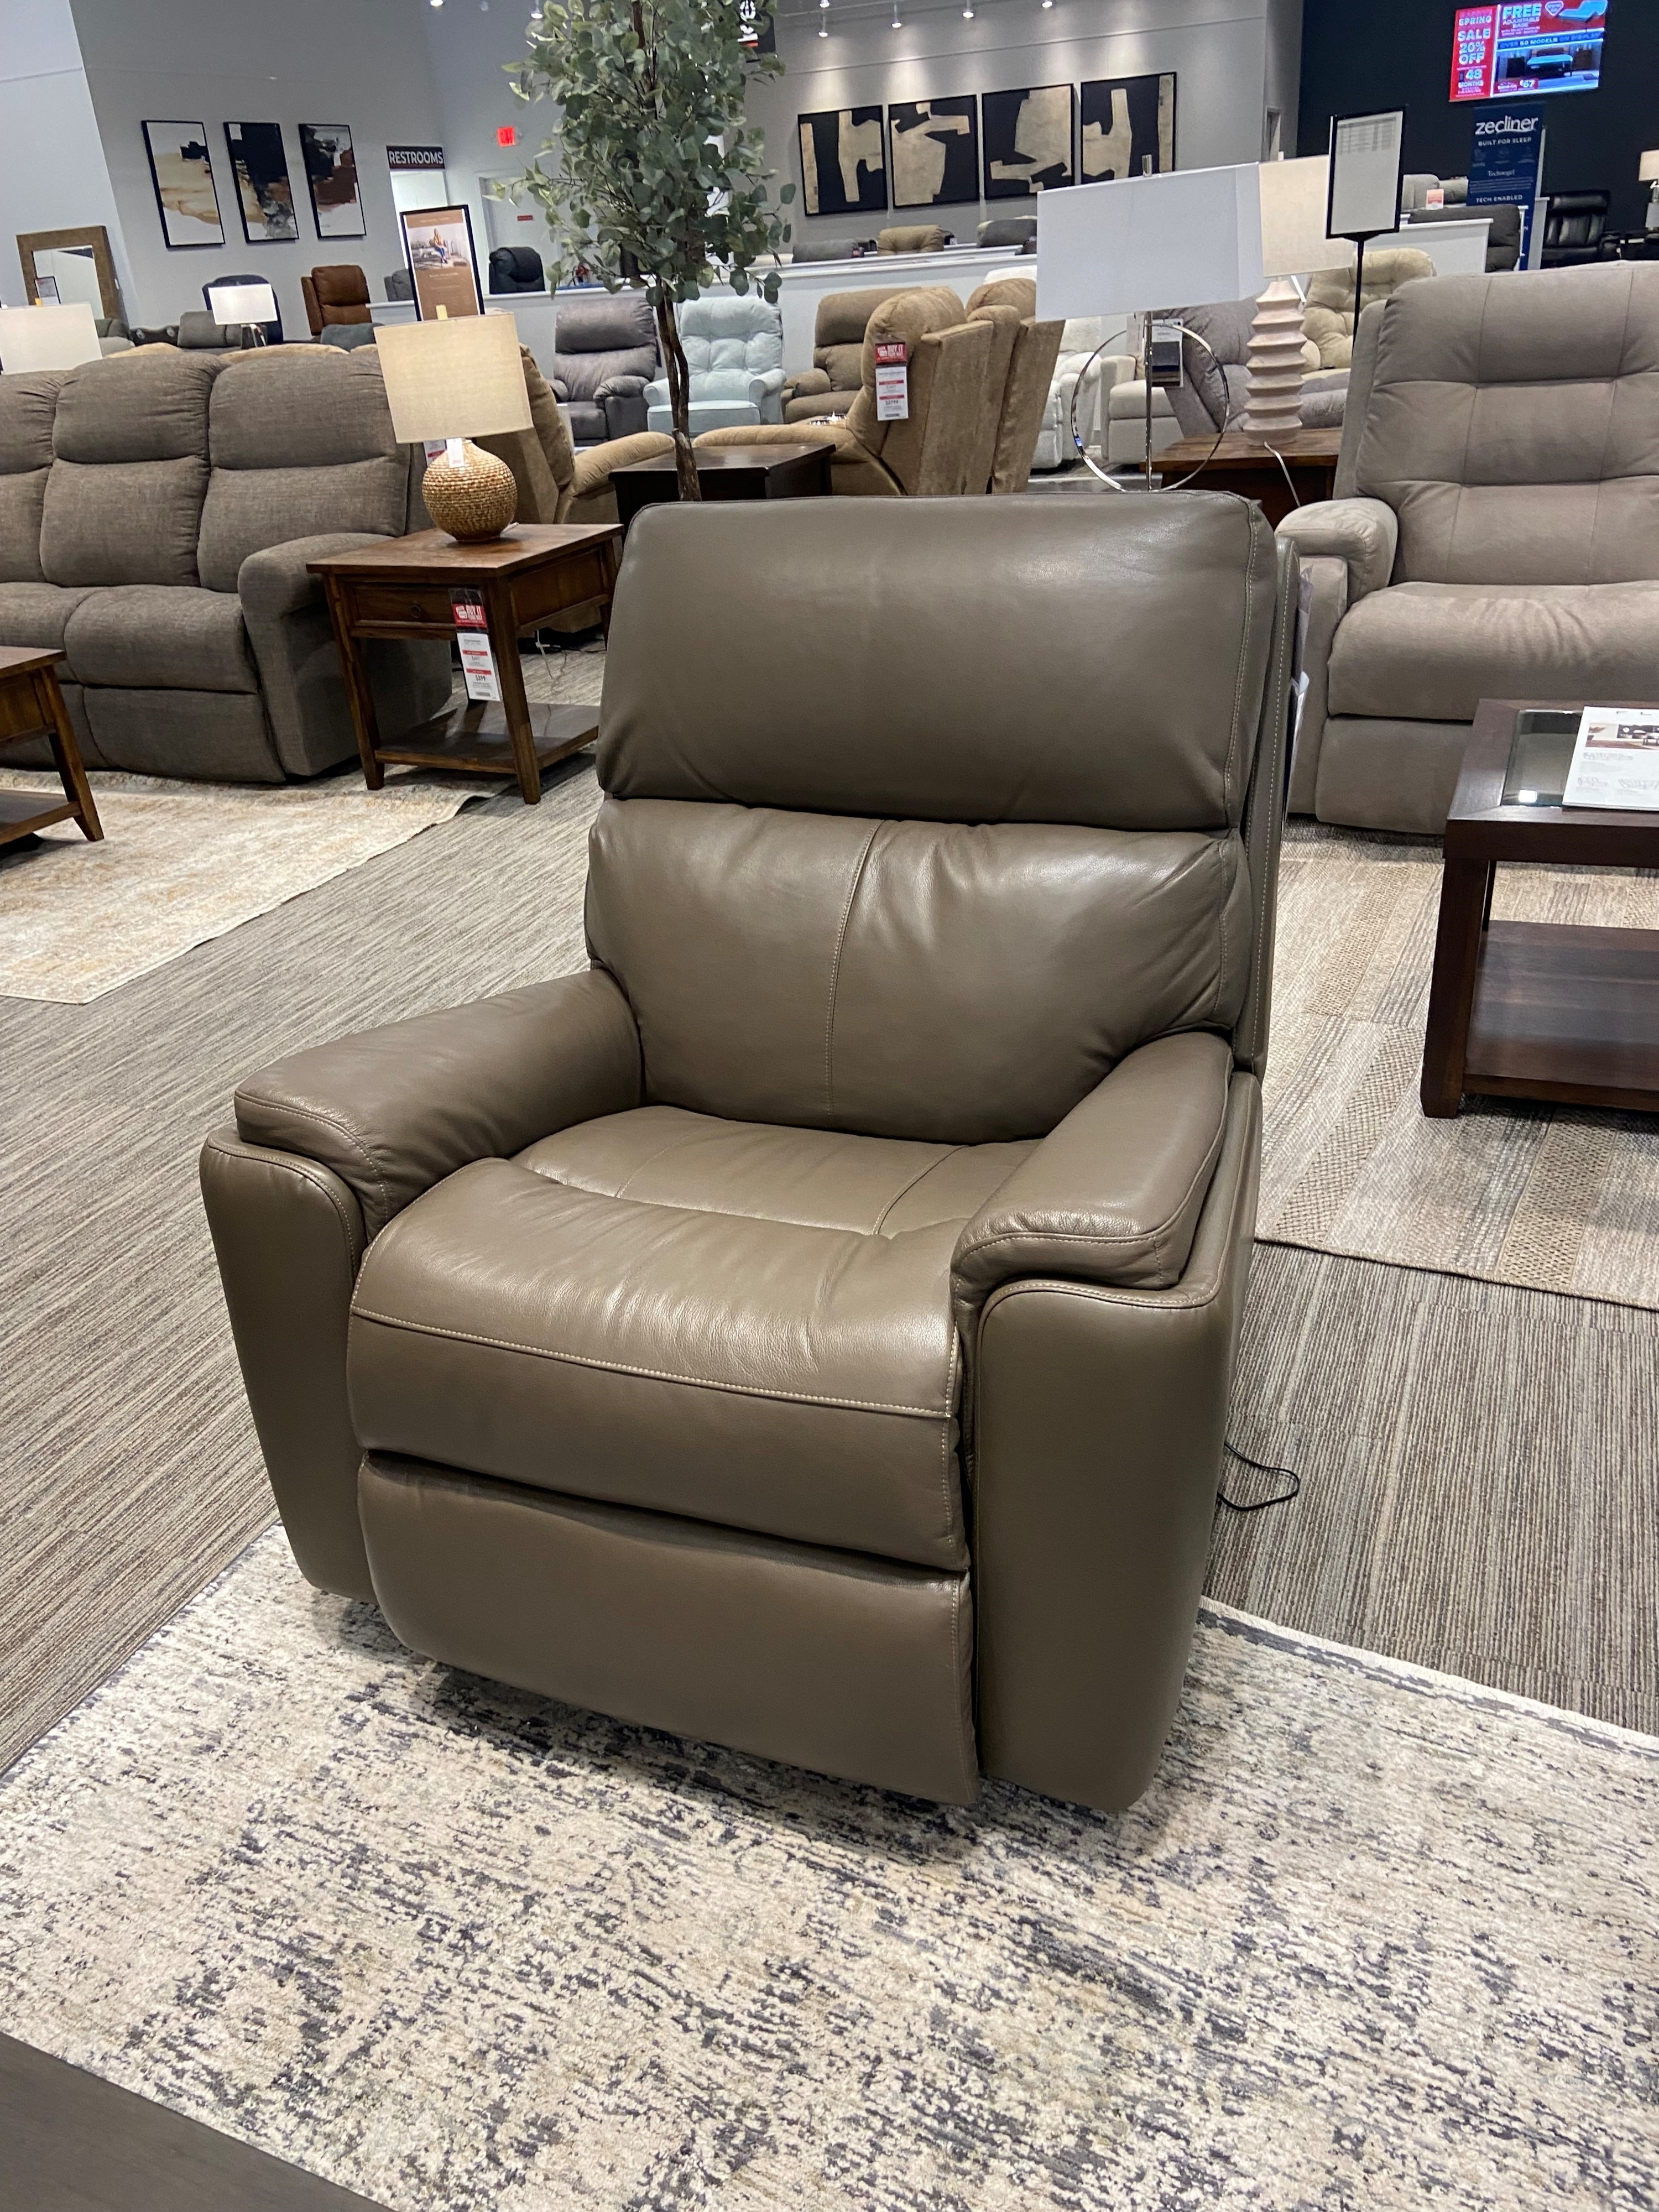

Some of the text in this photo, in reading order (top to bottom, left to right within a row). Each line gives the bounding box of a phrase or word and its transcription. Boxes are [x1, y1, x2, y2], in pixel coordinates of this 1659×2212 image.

[1503, 3, 1542, 19] FREE
[1459, 15, 1492, 26] SPRING
[1458, 28, 1491, 41] SALE
[1459, 41, 1486, 54] 20%
[1459, 53, 1484, 65] OFF
[1465, 69, 1483, 80] 48
[1475, 115, 1539, 135] zecliner
[388, 151, 443, 164] RESTROOMS
